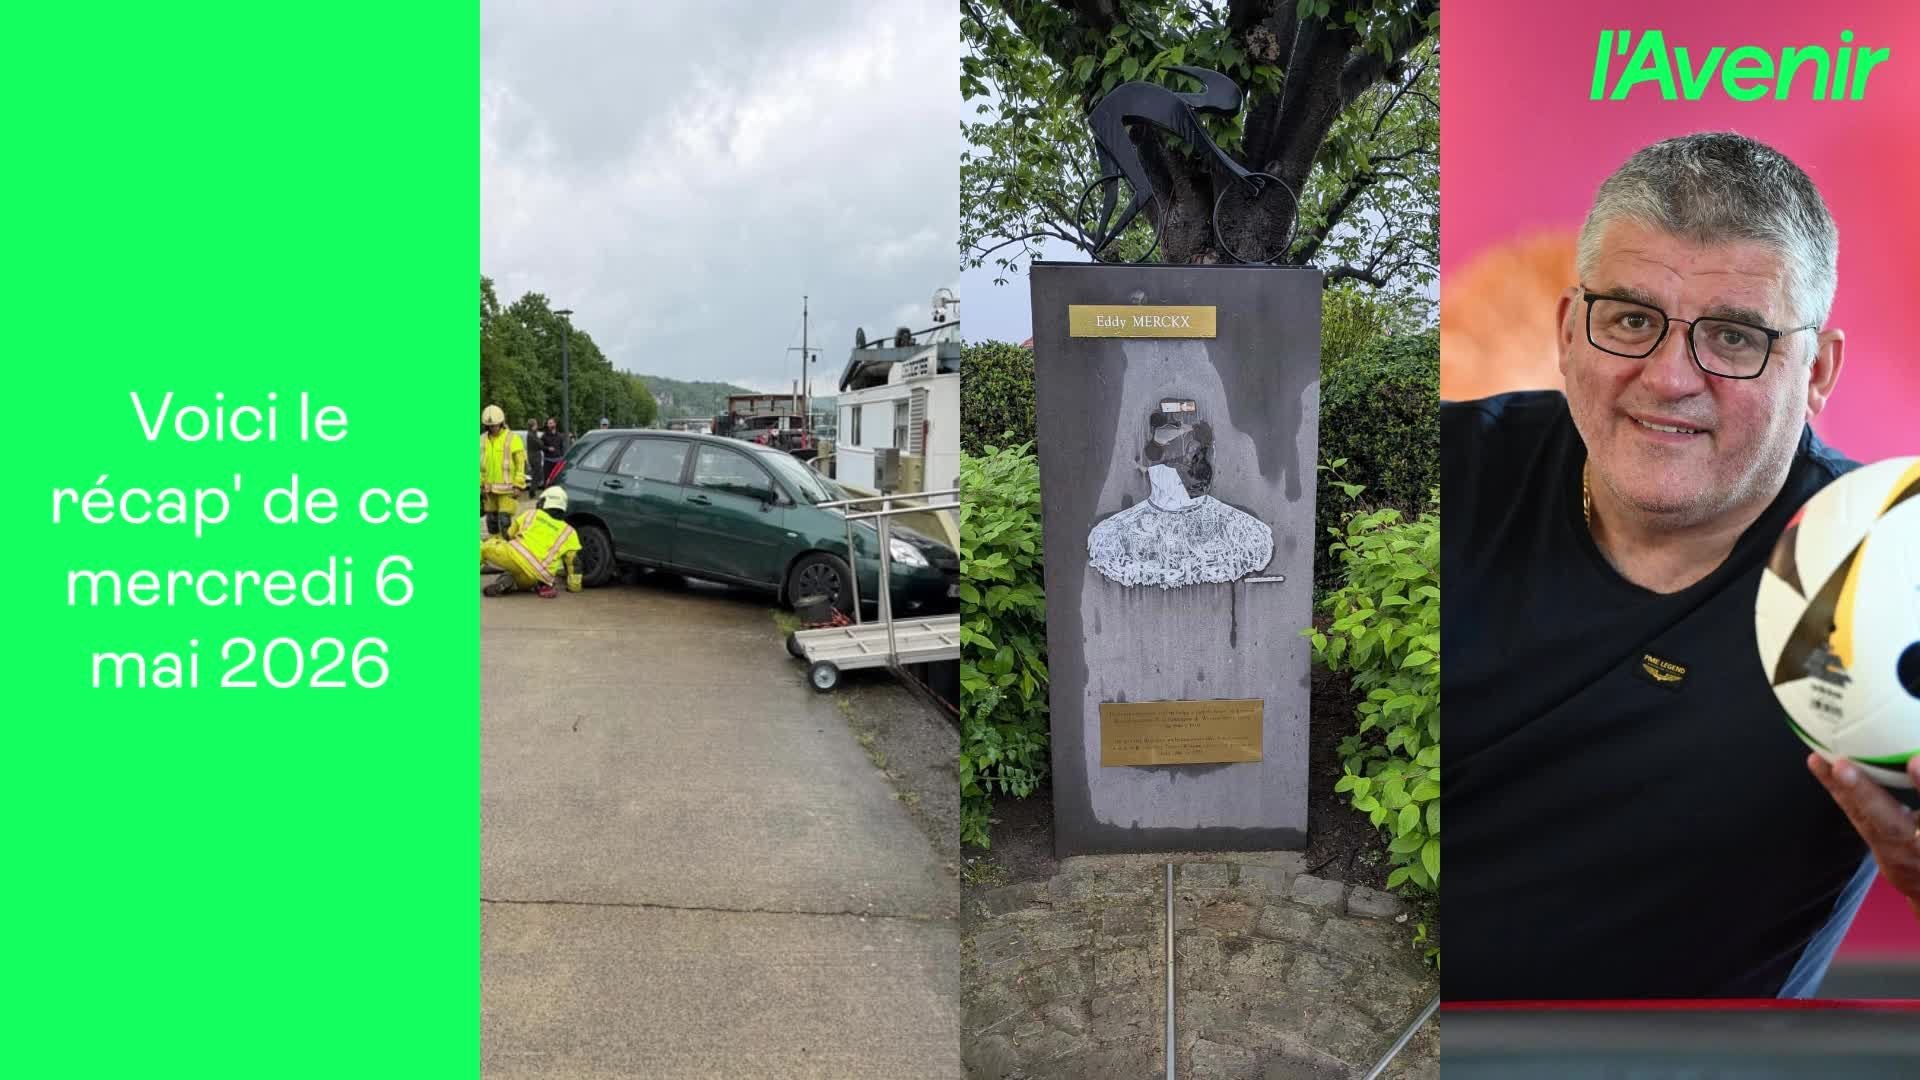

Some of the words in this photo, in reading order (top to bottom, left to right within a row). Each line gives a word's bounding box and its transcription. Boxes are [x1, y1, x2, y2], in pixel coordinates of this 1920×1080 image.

[1096, 315, 1127, 329] Eddy
[1132, 315, 1190, 328] MERCKX
[1660, 661, 1686, 674] LEGEND
